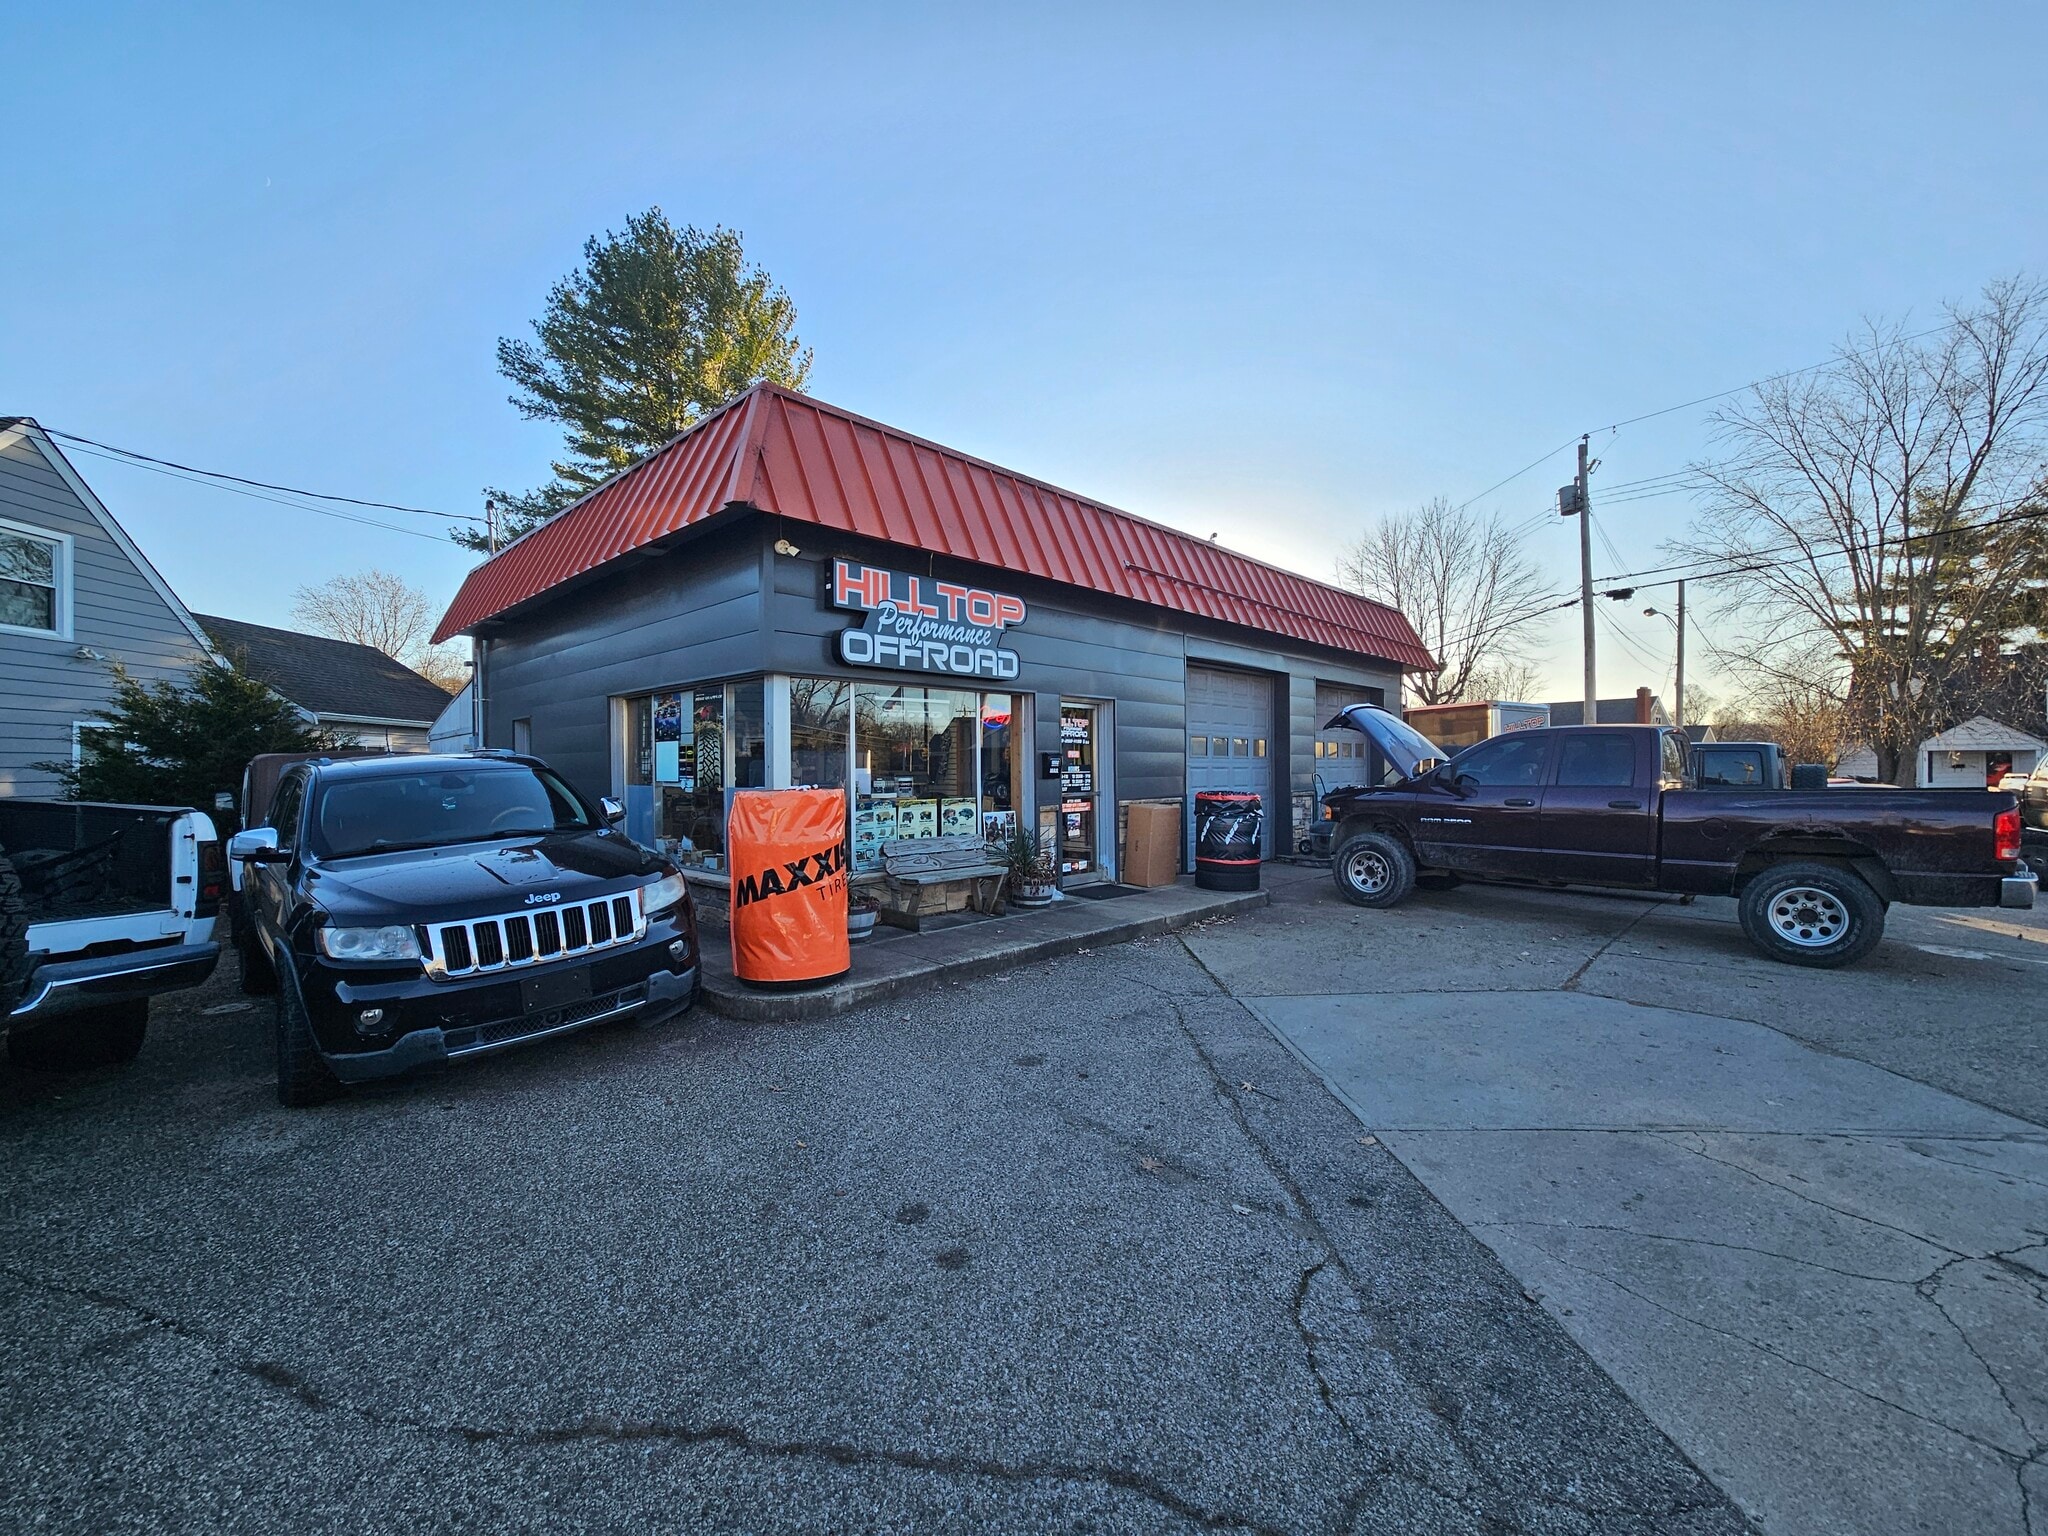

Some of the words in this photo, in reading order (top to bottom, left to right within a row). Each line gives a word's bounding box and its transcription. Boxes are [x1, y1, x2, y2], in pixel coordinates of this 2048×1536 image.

[836, 561, 1026, 629] HILLTOP
[877, 600, 992, 646] Performance
[843, 630, 1019, 678] OFFROAD
[1504, 715, 1545, 733] HILLTOP
[524, 892, 561, 904] Jeep
